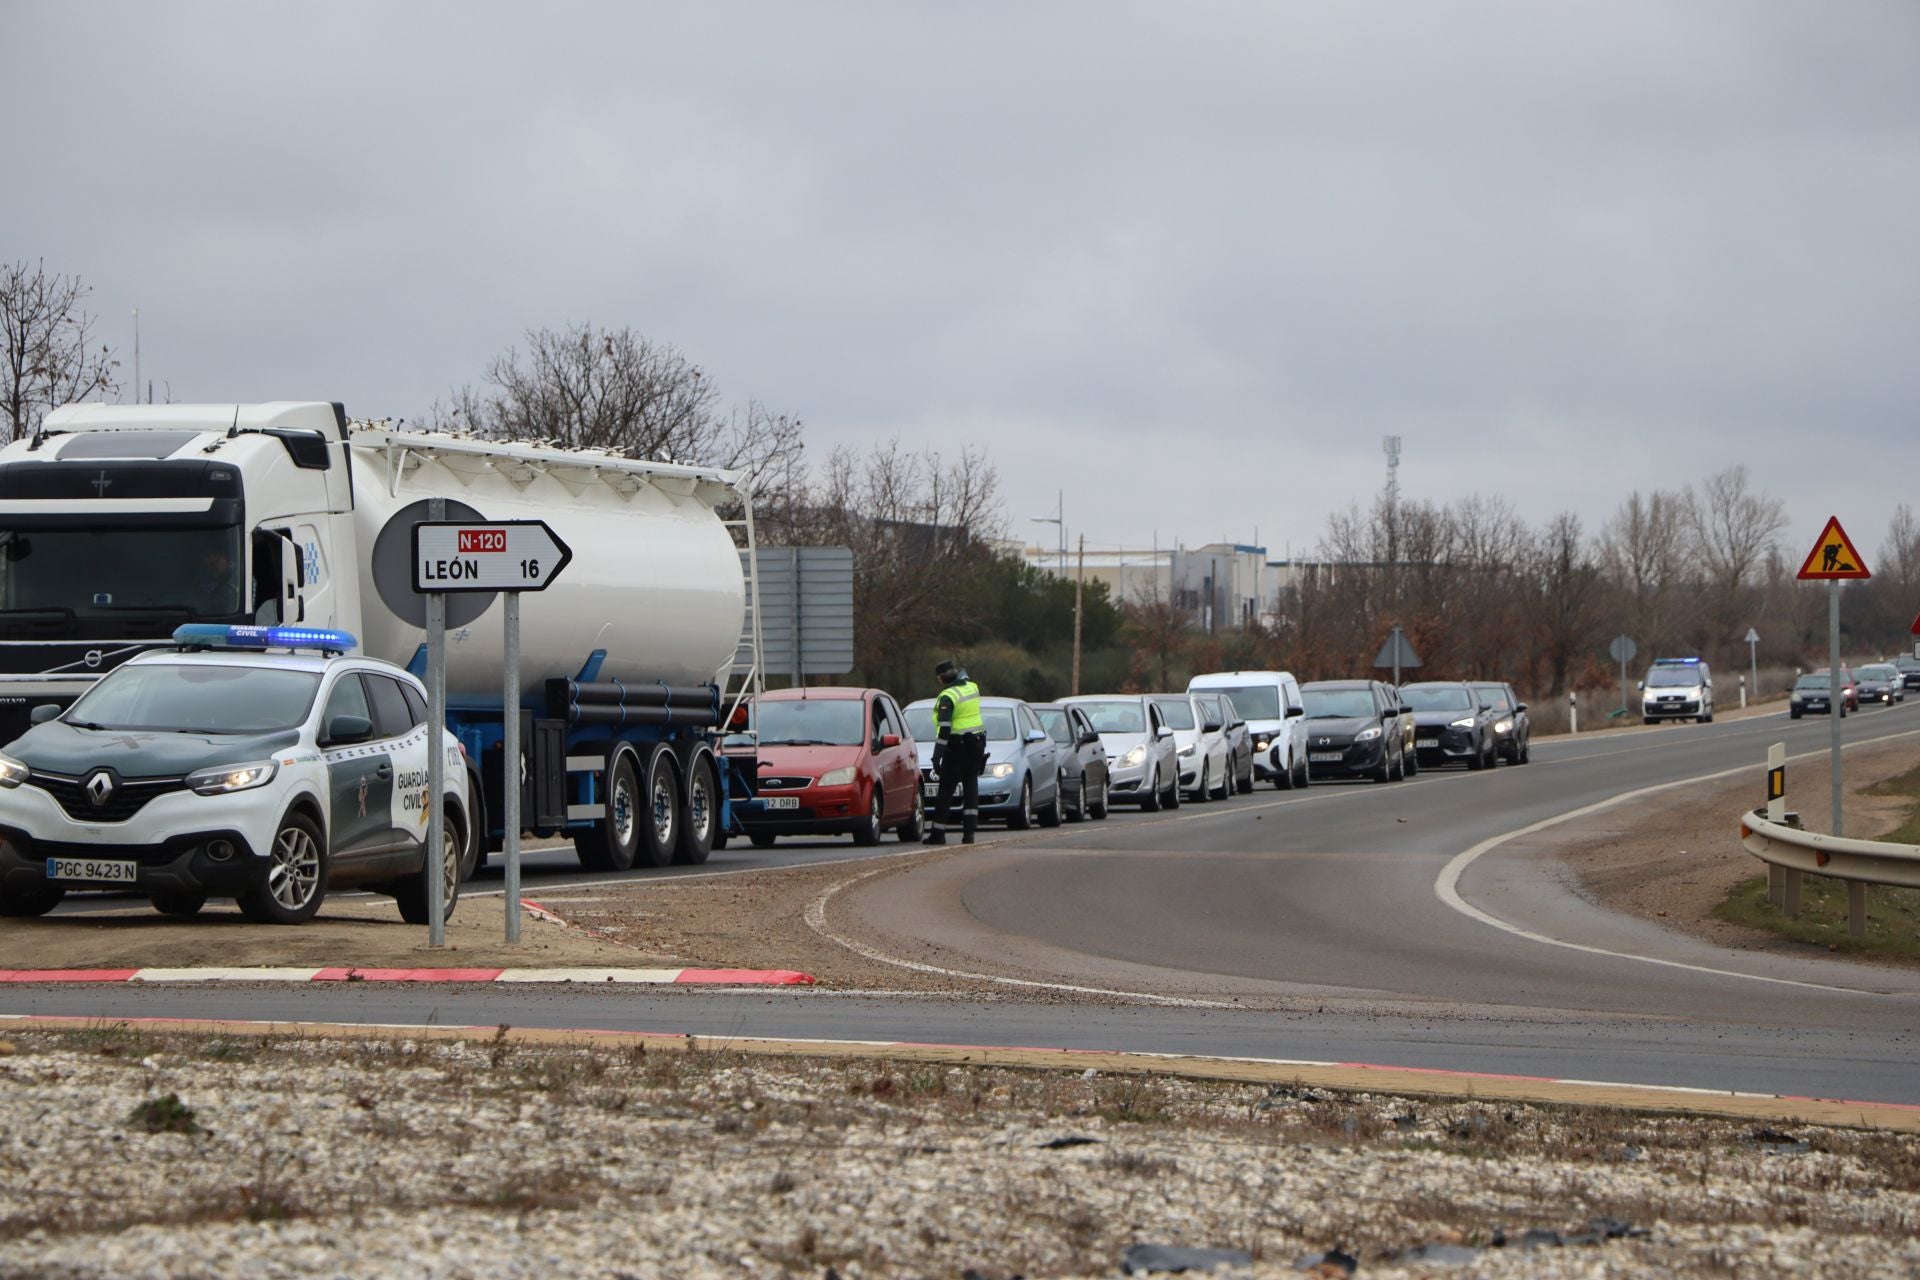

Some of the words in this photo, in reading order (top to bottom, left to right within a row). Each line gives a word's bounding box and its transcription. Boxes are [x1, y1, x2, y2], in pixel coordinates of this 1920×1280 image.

[460, 533, 504, 549] N-120
[425, 556, 478, 580] LEÓN
[520, 559, 540, 579] 16
[403, 792, 422, 811] CIVIL
[779, 798, 797, 808] DRB
[55, 861, 82, 877] PGC
[85, 863, 121, 879] 9423
[124, 864, 135, 879] N
